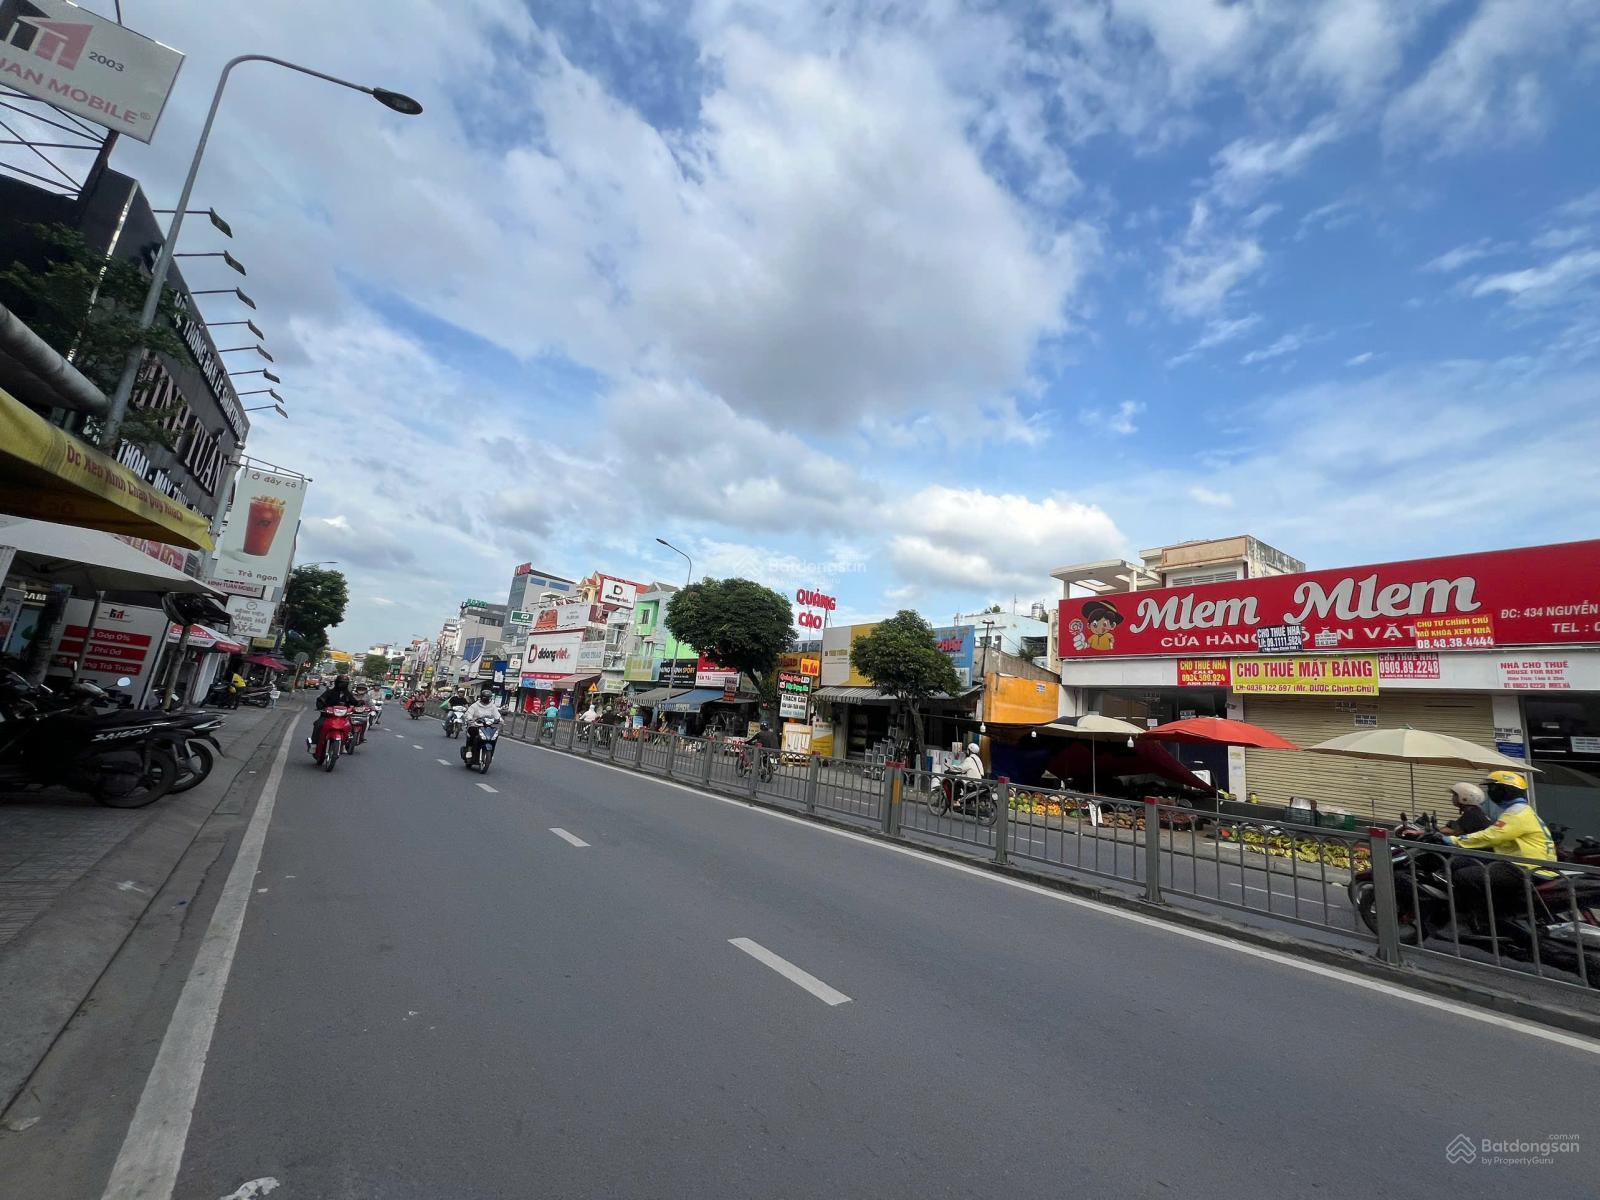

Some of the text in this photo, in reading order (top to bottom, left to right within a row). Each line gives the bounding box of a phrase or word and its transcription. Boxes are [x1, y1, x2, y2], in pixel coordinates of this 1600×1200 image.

[88, 51, 125, 73] 2003
[47, 77, 138, 125] MOBILE
[263, 474, 281, 488] đây
[282, 476, 297, 488] có
[238, 570, 278, 582] Trà ngon
[796, 588, 837, 611] QUẢNG
[1129, 573, 1482, 634] Mlem Mlem
[1501, 600, 1598, 619] ĐC: 434 NGUYỄN
[799, 610, 822, 630] CÁO
[1552, 622, 1579, 633] TEL
[1160, 633, 1200, 647] CỬA
[1416, 636, 1495, 649] 08.48.38.4444
[1180, 661, 1193, 670] CHO
[1236, 662, 1259, 678] CHO
[1263, 658, 1294, 678] THUÊ
[1298, 658, 1327, 681] MẶT
[1380, 661, 1439, 674] 0909.89.2248
